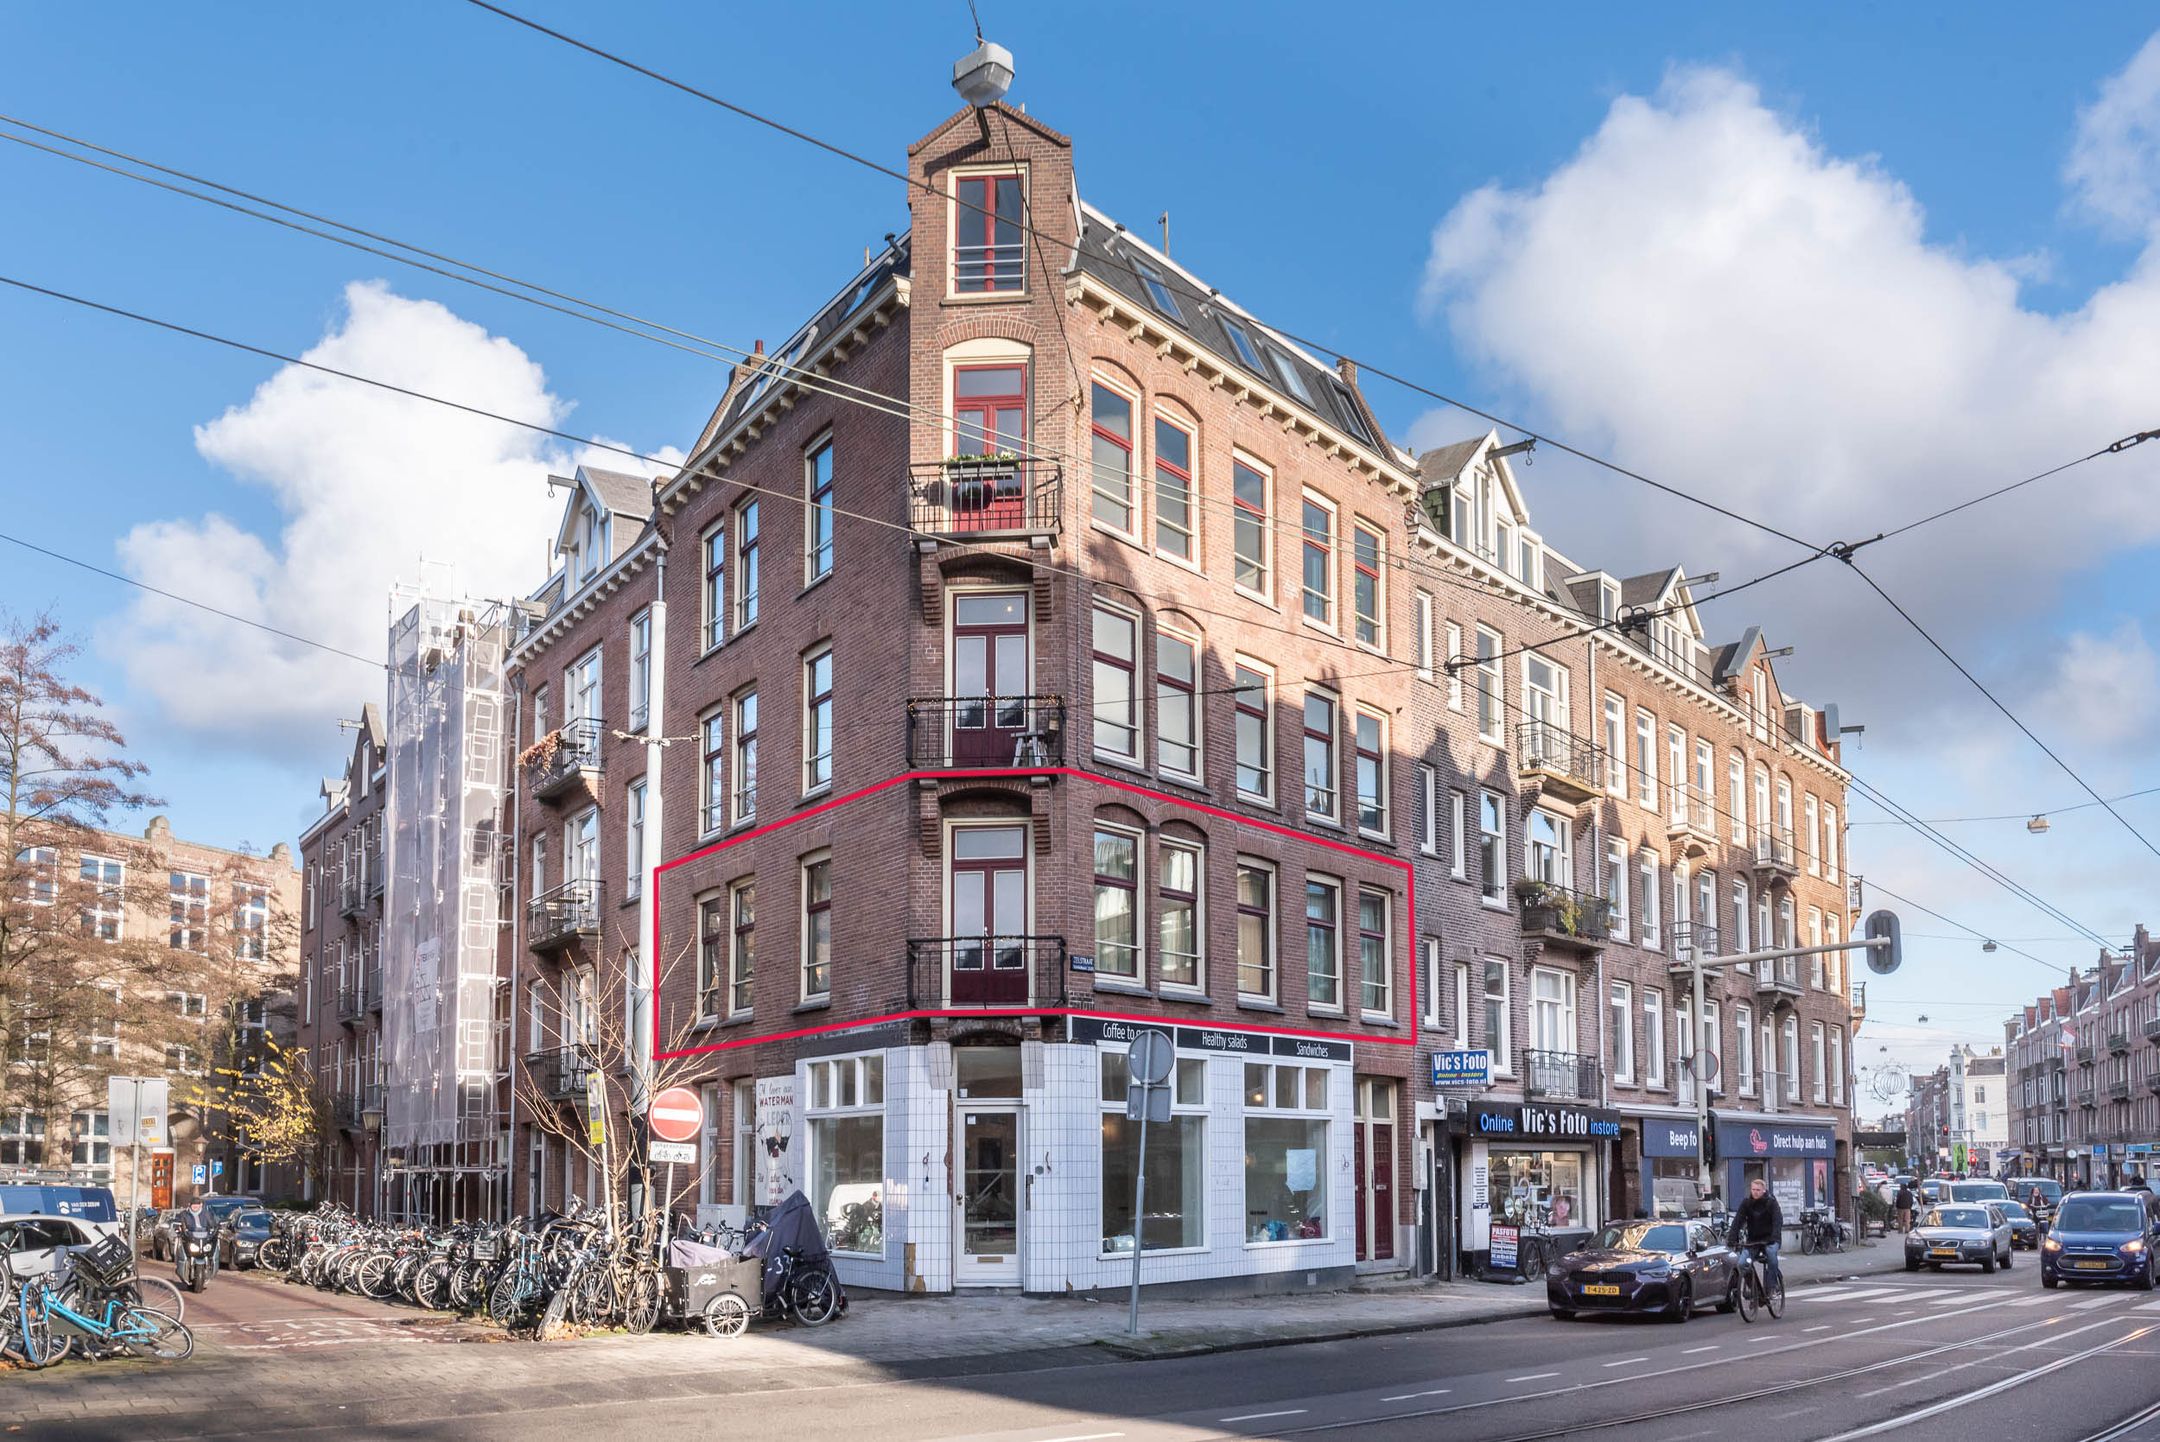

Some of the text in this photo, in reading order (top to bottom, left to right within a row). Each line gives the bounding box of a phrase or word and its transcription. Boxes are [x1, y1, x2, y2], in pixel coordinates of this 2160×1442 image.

[1103, 1022, 1126, 1040] Coffee
[1127, 1025, 1135, 1040] to
[1202, 1032, 1248, 1050] Healthy salads
[1296, 1041, 1329, 1058] Sandwiches
[1433, 1053, 1487, 1071] Vic's Foto
[759, 1095, 794, 1107] WATERMAN
[1480, 1108, 1619, 1135] Online Vic's Foto instore
[1669, 1130, 1688, 1150] Beep
[1773, 1133, 1827, 1152] Direct hulp aan huis
